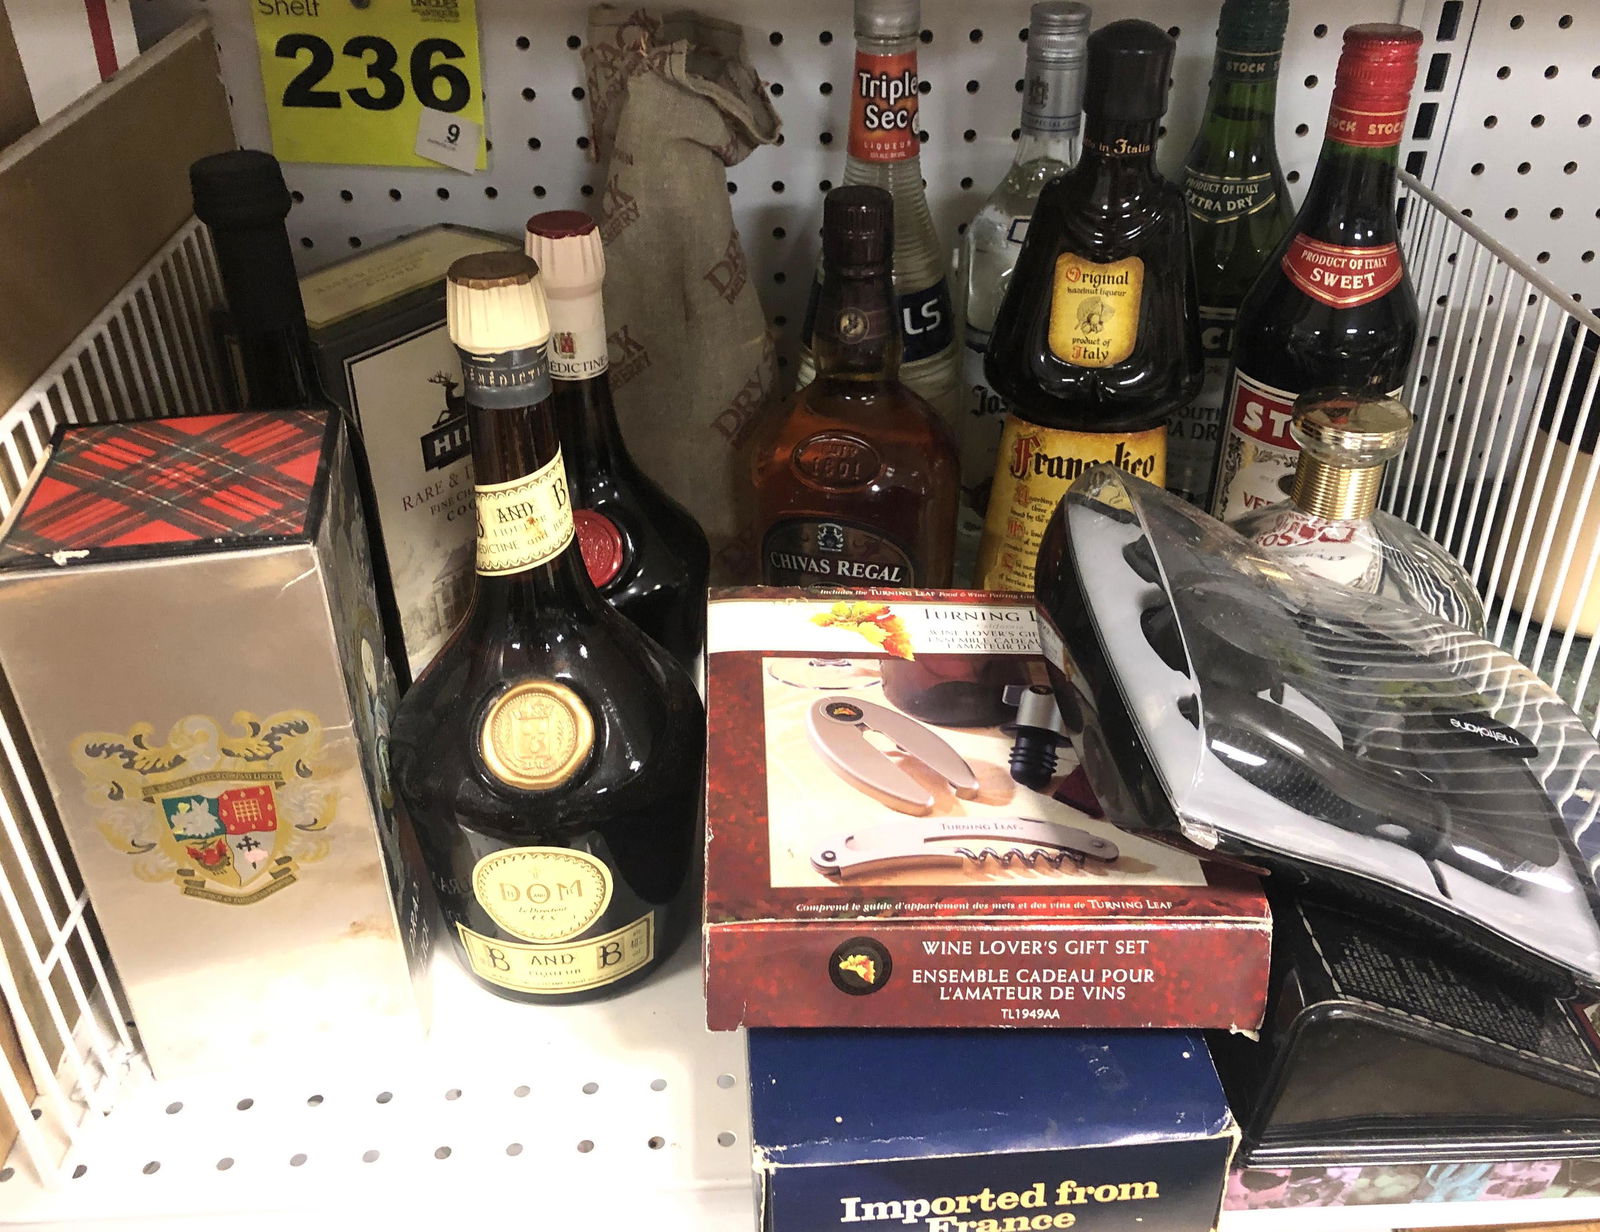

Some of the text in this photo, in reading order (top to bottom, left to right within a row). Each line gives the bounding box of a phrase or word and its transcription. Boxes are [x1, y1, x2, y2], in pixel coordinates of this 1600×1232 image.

[275, 33, 471, 113] 236
[1226, 61, 1267, 73] STOCK
[859, 71, 918, 105] Triple
[865, 104, 908, 130] Sec
[447, 124, 461, 144] 9
[1185, 177, 1260, 195] PRODUCT OF ITALY
[1185, 189, 1253, 212] EXTRA DRY
[1300, 249, 1389, 271] PRODUCT OF ITALY
[1065, 266, 1129, 288] Original
[1309, 267, 1376, 290] SWEET
[1072, 335, 1113, 347] product of
[1071, 344, 1110, 361] Italy
[402, 481, 444, 511] RARE
[496, 501, 534, 524] AND
[553, 477, 567, 511] B
[770, 551, 903, 583] CHIVAS REGAL
[868, 588, 913, 597] TURNING
[796, 902, 849, 913] Comprend
[851, 902, 861, 911] le
[863, 902, 893, 912] guide
[972, 902, 989, 910] des
[992, 902, 1015, 910] mets
[1018, 901, 1028, 910] et
[1030, 901, 1047, 910] des
[1050, 901, 1071, 910] vins
[1073, 901, 1086, 910] de
[1087, 899, 1143, 910] TURNING
[1146, 899, 1173, 910] LEAF
[486, 944, 511, 972] B
[531, 953, 576, 966] AND
[599, 941, 622, 969] B
[922, 939, 1149, 955] WINE LOVER'S GIFT SET
[912, 968, 1155, 984] ENSEMBLE CADEAU POUR
[939, 985, 1127, 1001] L'AMATEUR DE VINS
[1001, 1007, 1060, 1020] TL1949AA
[840, 1179, 1160, 1225] Imported from
[925, 1211, 1076, 1232] France
